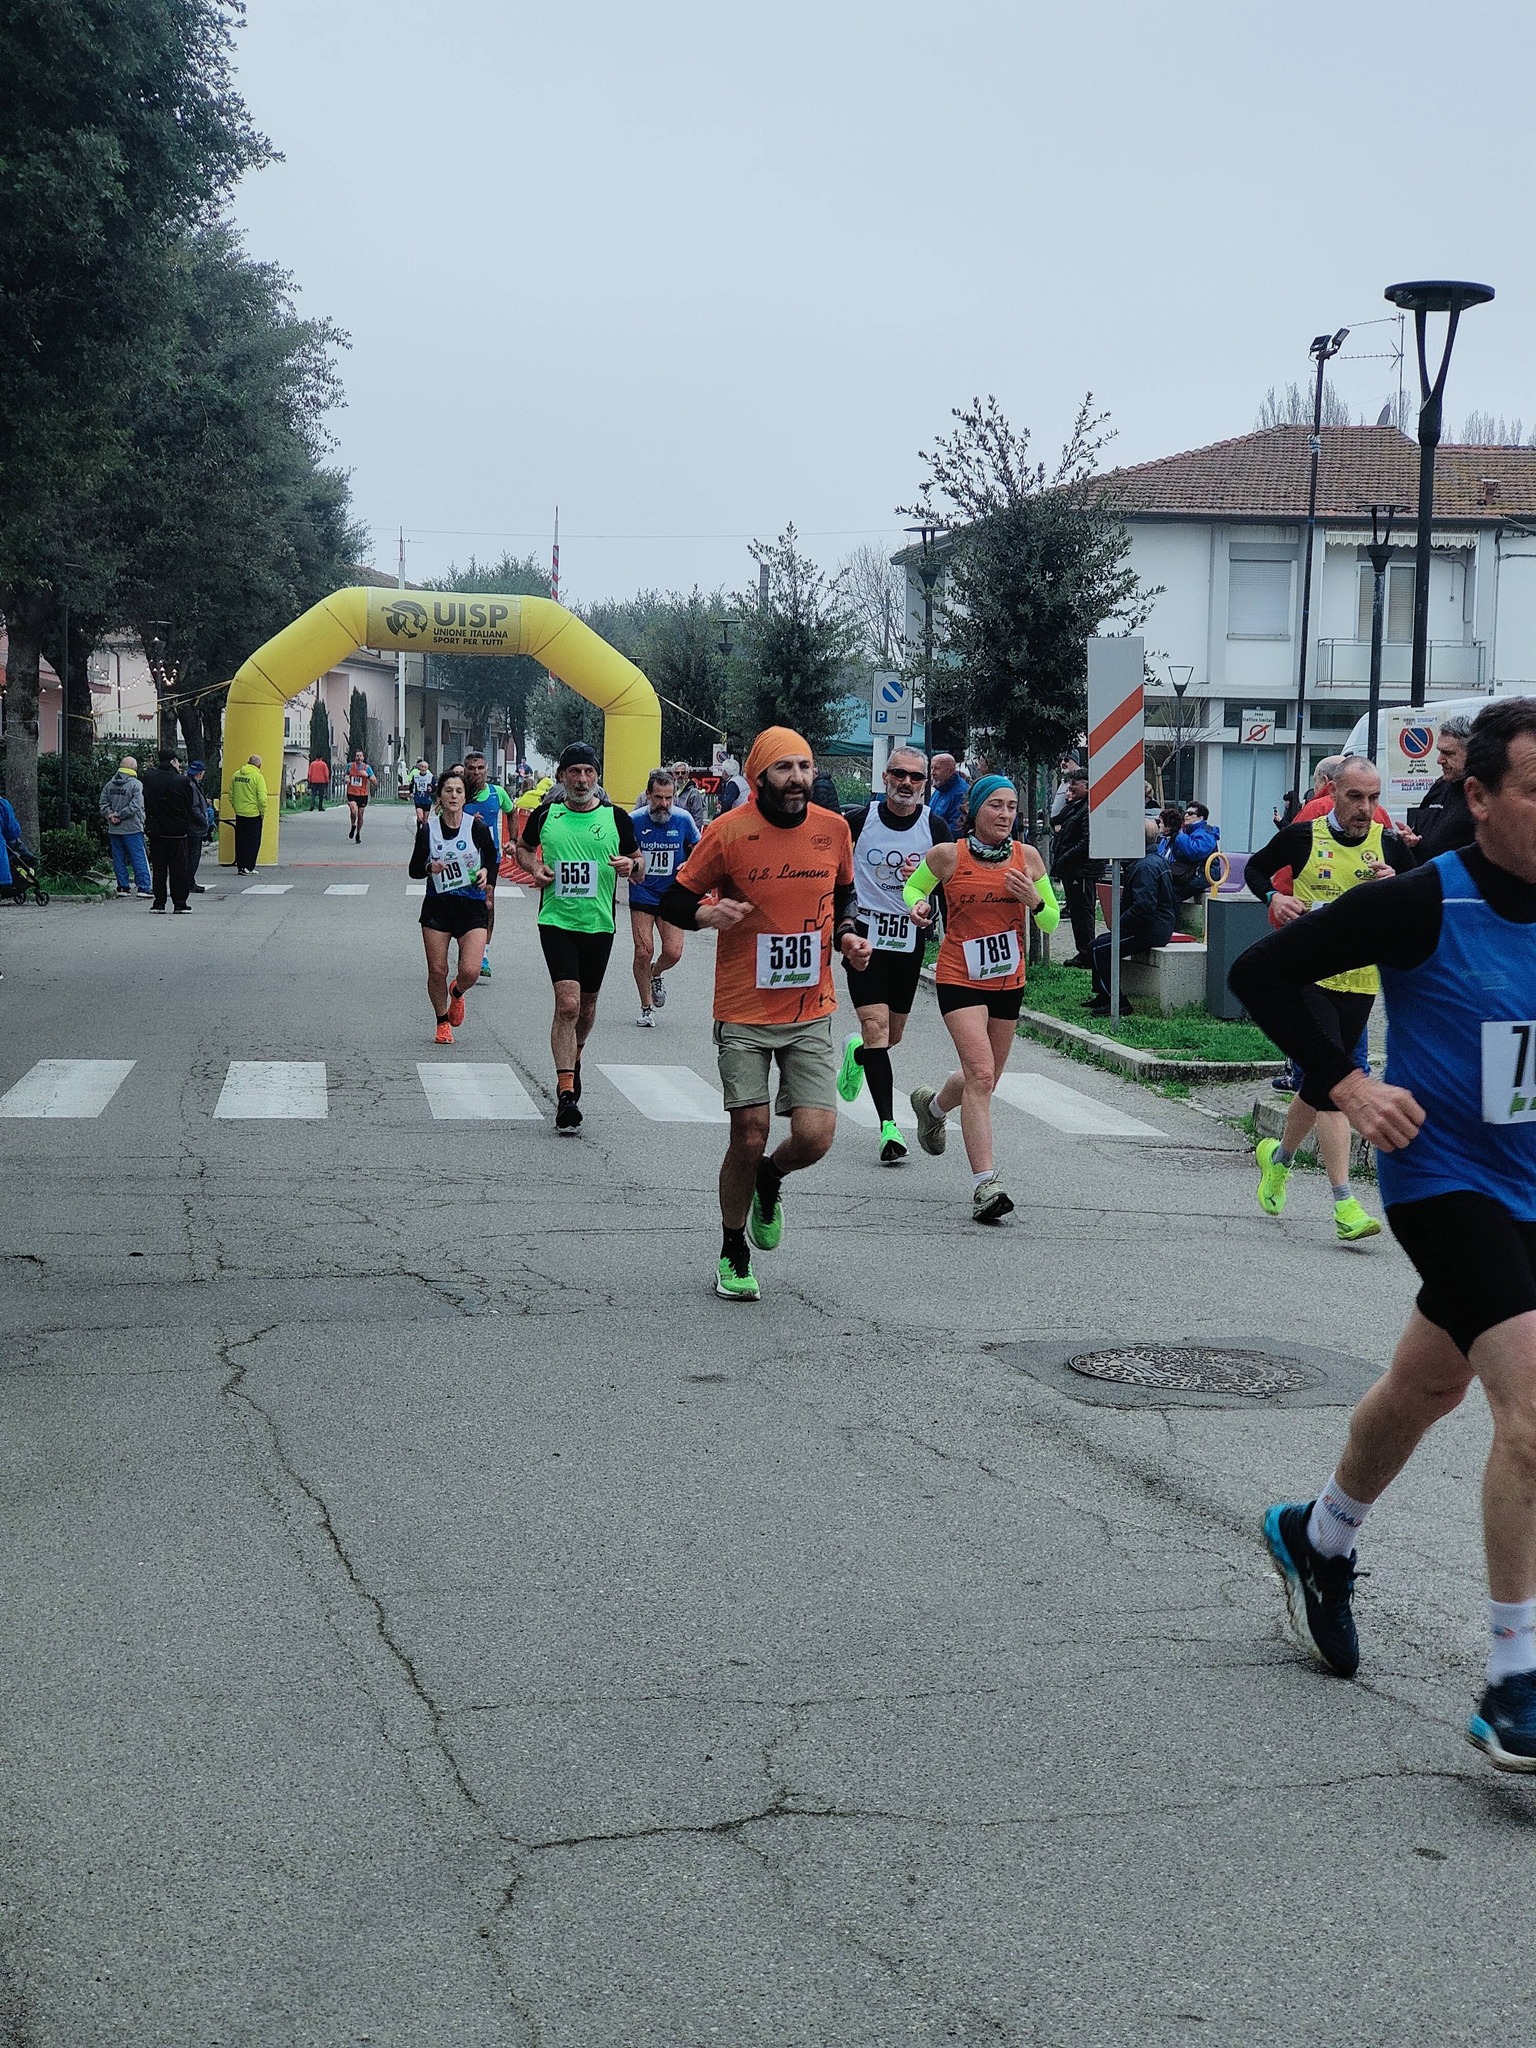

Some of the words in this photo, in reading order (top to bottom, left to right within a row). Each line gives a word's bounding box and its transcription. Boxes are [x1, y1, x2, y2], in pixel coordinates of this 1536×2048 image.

[433, 601, 508, 628] UISP
[433, 628, 467, 637] UNIONE
[470, 629, 509, 639] ITALIANA
[433, 636, 460, 645] SPORT
[650, 852, 668, 867] 718
[776, 863, 830, 879] Lamone
[561, 862, 590, 885] 553
[982, 888, 1023, 904] Lamon
[877, 914, 910, 939] 556
[770, 935, 812, 970] 536
[975, 934, 1011, 966] 789
[1512, 1025, 1536, 1088] 7
